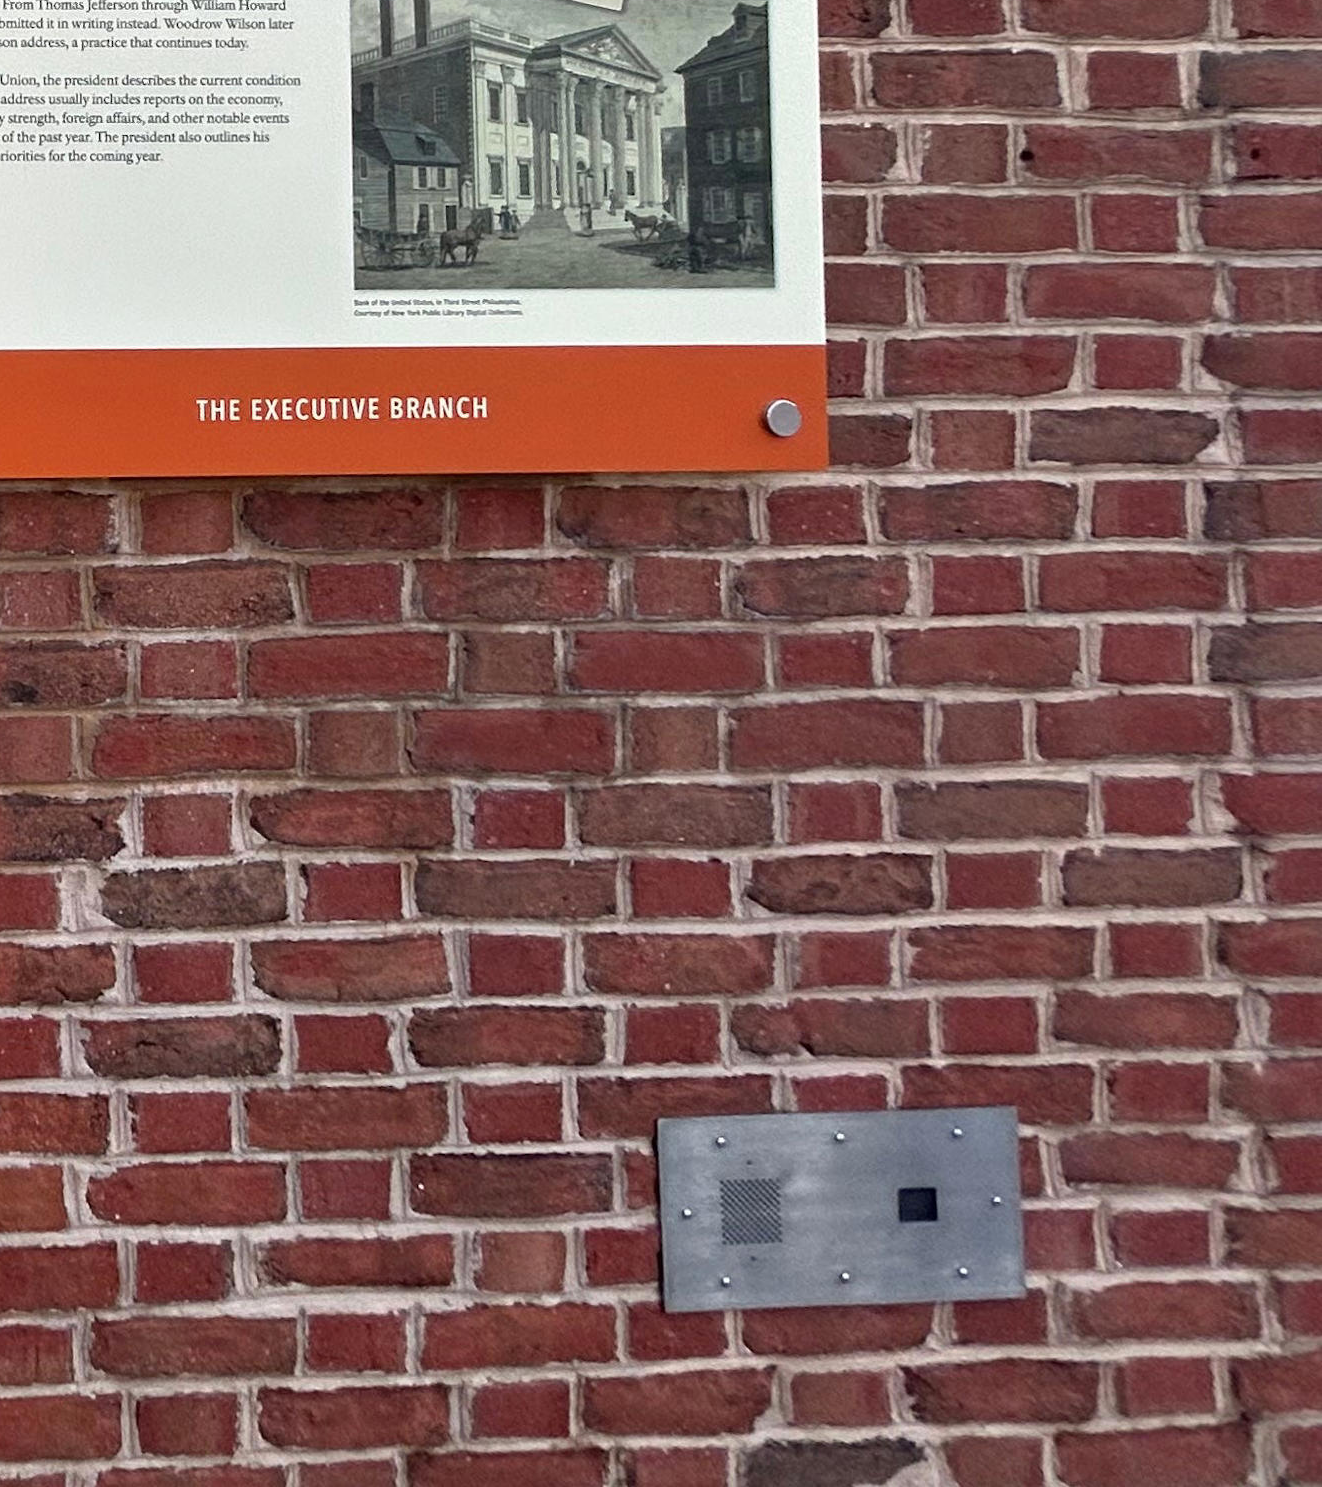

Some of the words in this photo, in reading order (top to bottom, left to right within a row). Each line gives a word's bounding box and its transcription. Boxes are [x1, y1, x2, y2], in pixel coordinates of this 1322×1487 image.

[196, 399, 240, 421] THE
[252, 398, 379, 420] EXECUTIVE
[390, 397, 487, 419] BRANCH
